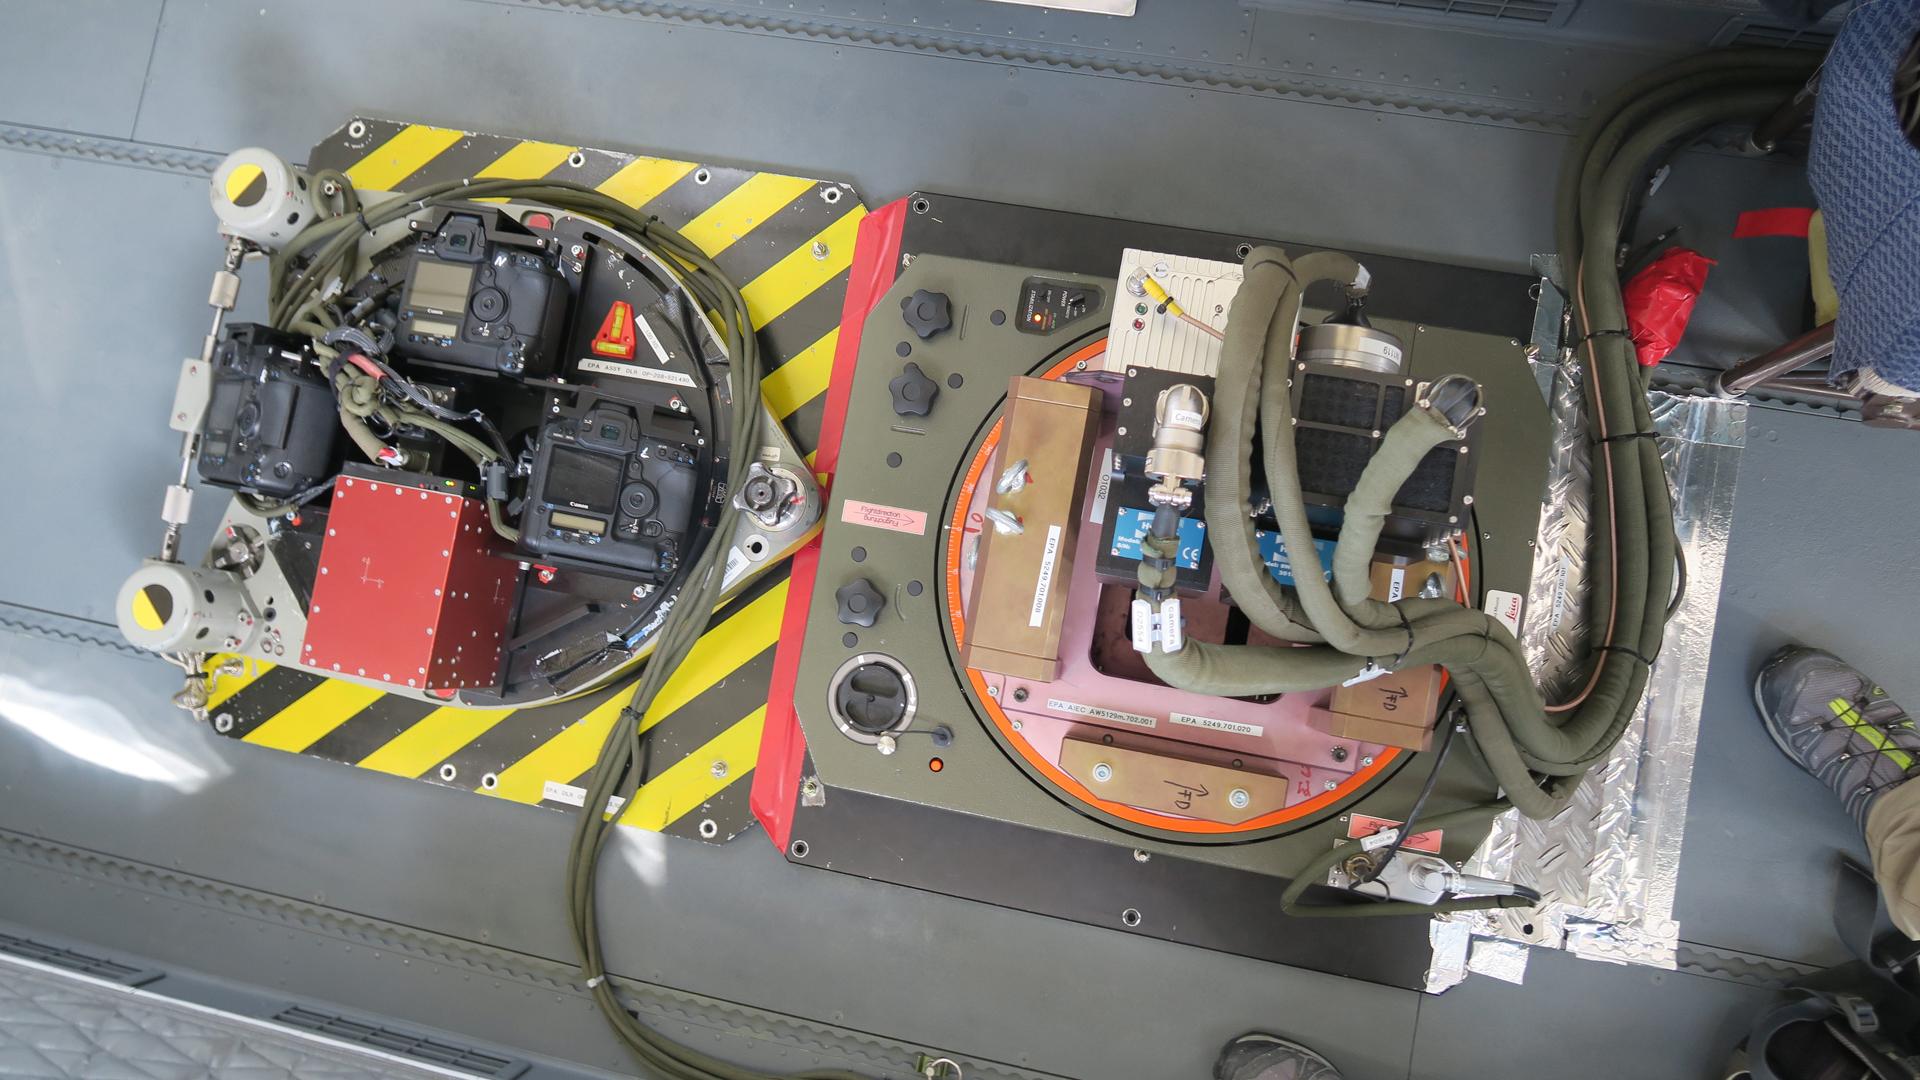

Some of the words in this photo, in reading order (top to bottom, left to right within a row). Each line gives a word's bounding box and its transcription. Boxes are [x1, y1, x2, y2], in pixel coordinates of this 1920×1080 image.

[1060, 290, 1068, 307] POWER
[569, 501, 589, 510] Canon
[860, 505, 902, 518] Flightdirection
[863, 513, 899, 527] Flugrichtung
[1047, 537, 1056, 554] EPA
[1392, 581, 1400, 599] EPA
[1504, 596, 1519, 623] Leica
[1049, 701, 1064, 710] EPA
[1181, 716, 1197, 725] EPA
